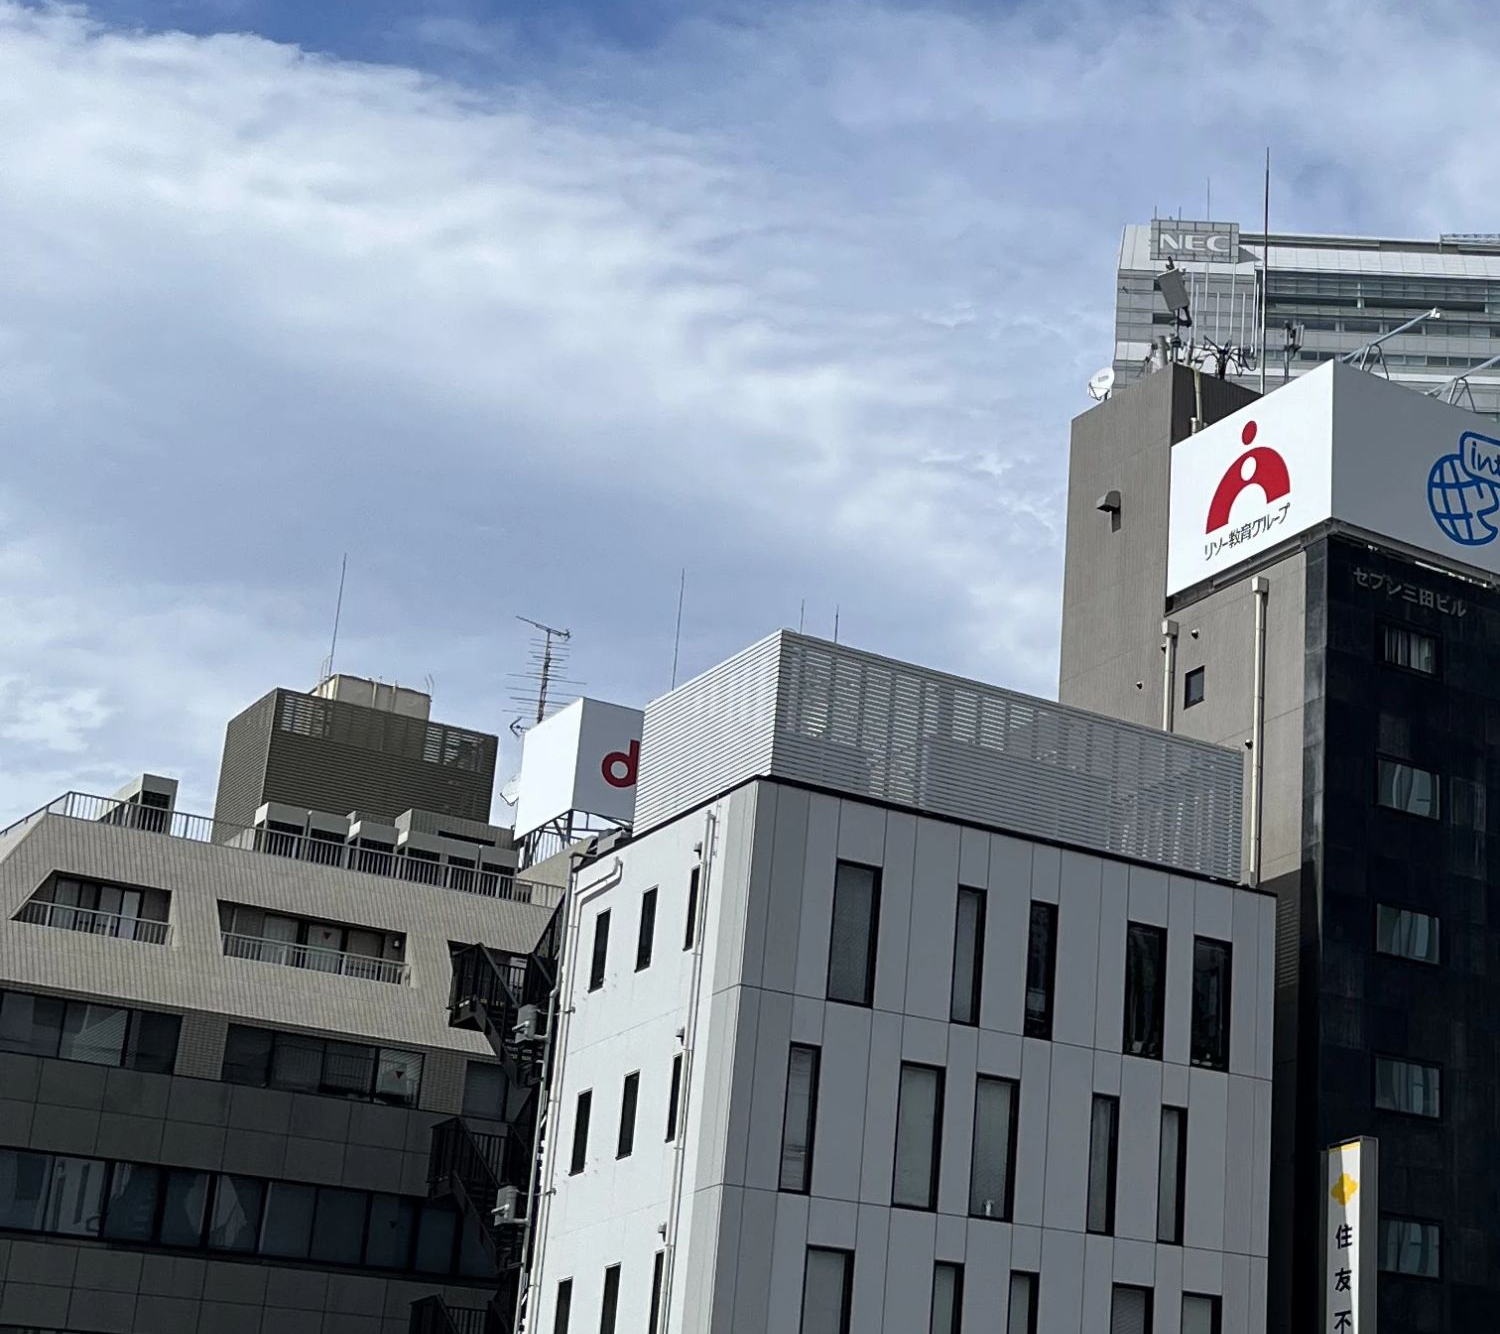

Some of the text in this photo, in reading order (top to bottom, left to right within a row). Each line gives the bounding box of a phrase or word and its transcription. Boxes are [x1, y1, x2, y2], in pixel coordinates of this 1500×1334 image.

[1204, 502, 1291, 561] リソー教育グループ
[1353, 567, 1467, 618] セブン三田ビル
